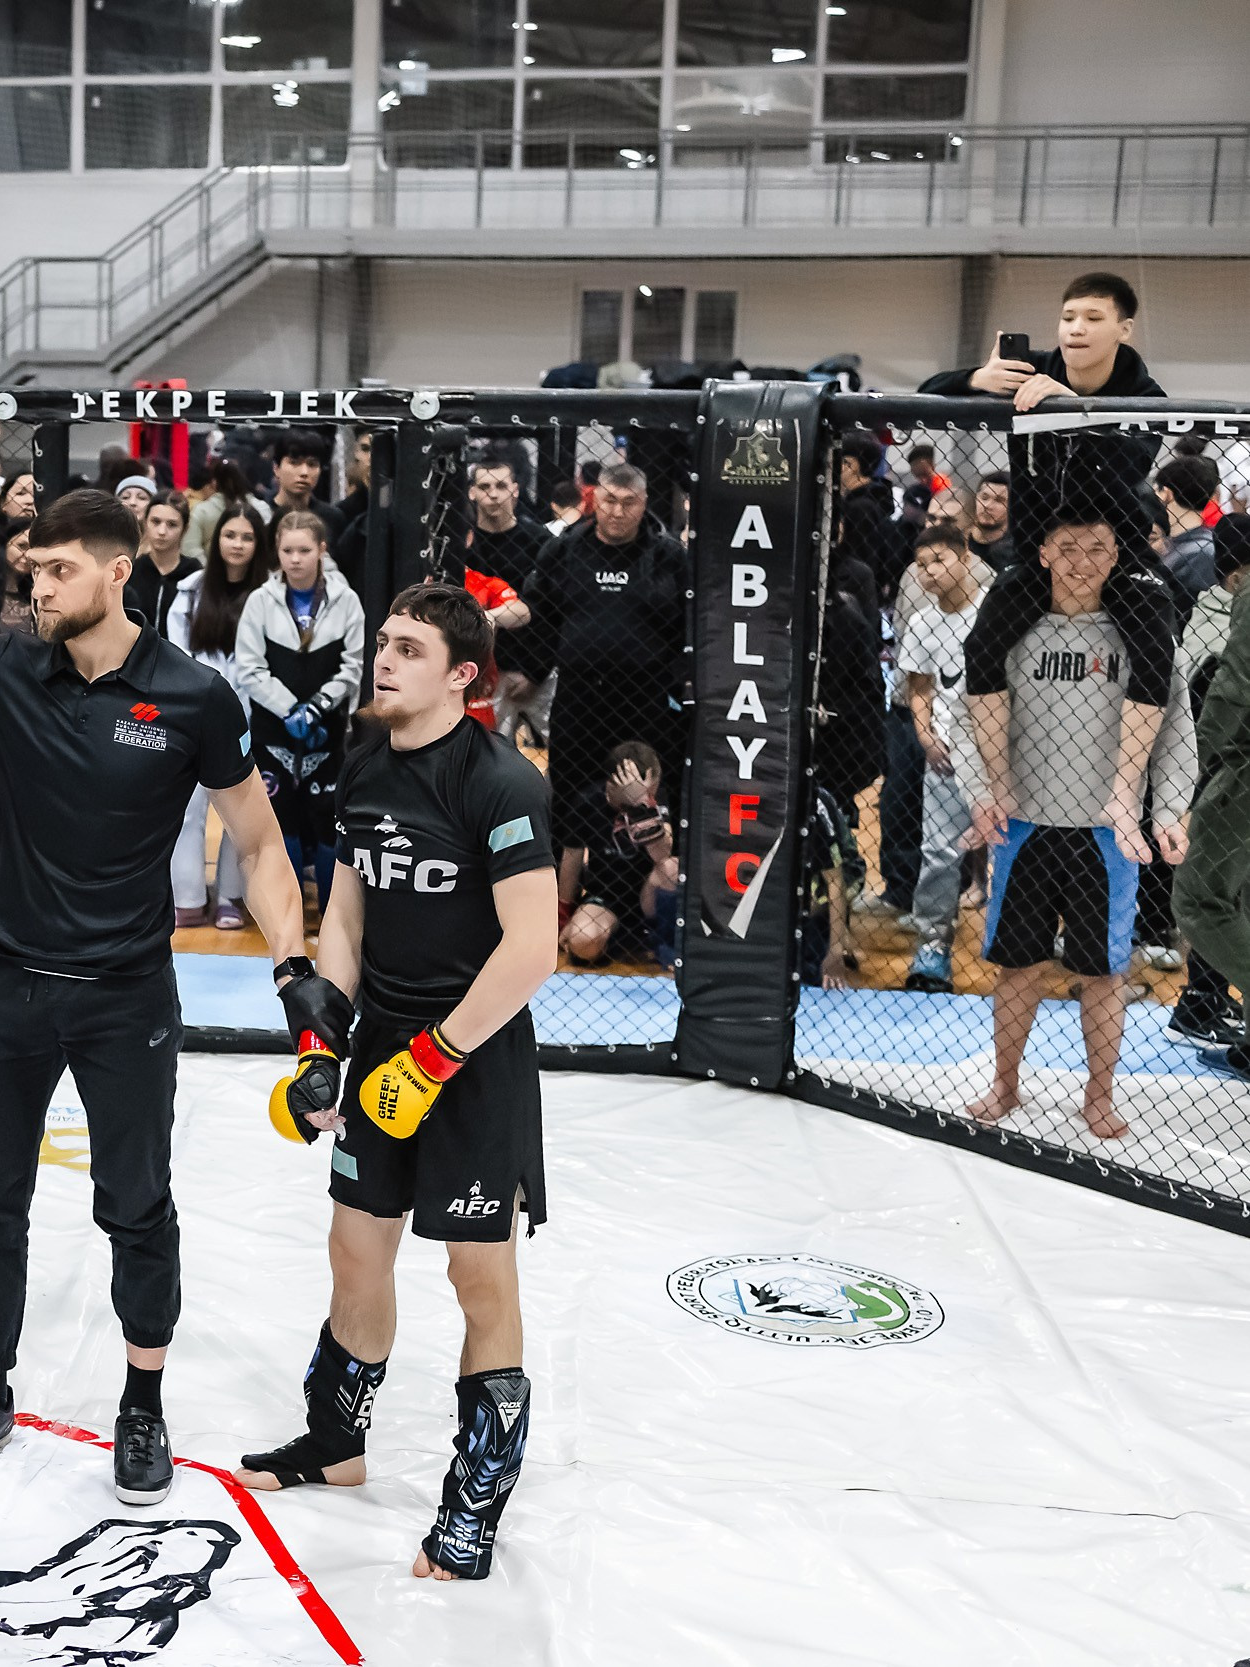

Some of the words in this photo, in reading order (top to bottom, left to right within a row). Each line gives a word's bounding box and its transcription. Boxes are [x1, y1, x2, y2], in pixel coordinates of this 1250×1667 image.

[70, 390, 227, 420] JEKPE
[266, 390, 359, 418] JEK
[726, 504, 774, 780] ABLAY
[113, 733, 167, 749] FEDERATION
[725, 793, 762, 895] FC
[353, 847, 459, 893] AFC
[378, 1074, 391, 1119] GREEN
[401, 1070, 429, 1094] IMMAF
[387, 1085, 400, 1120] HILL
[447, 1198, 500, 1217] AFC
[497, 1401, 523, 1409] RDX
[438, 1534, 484, 1556] IMMAF
